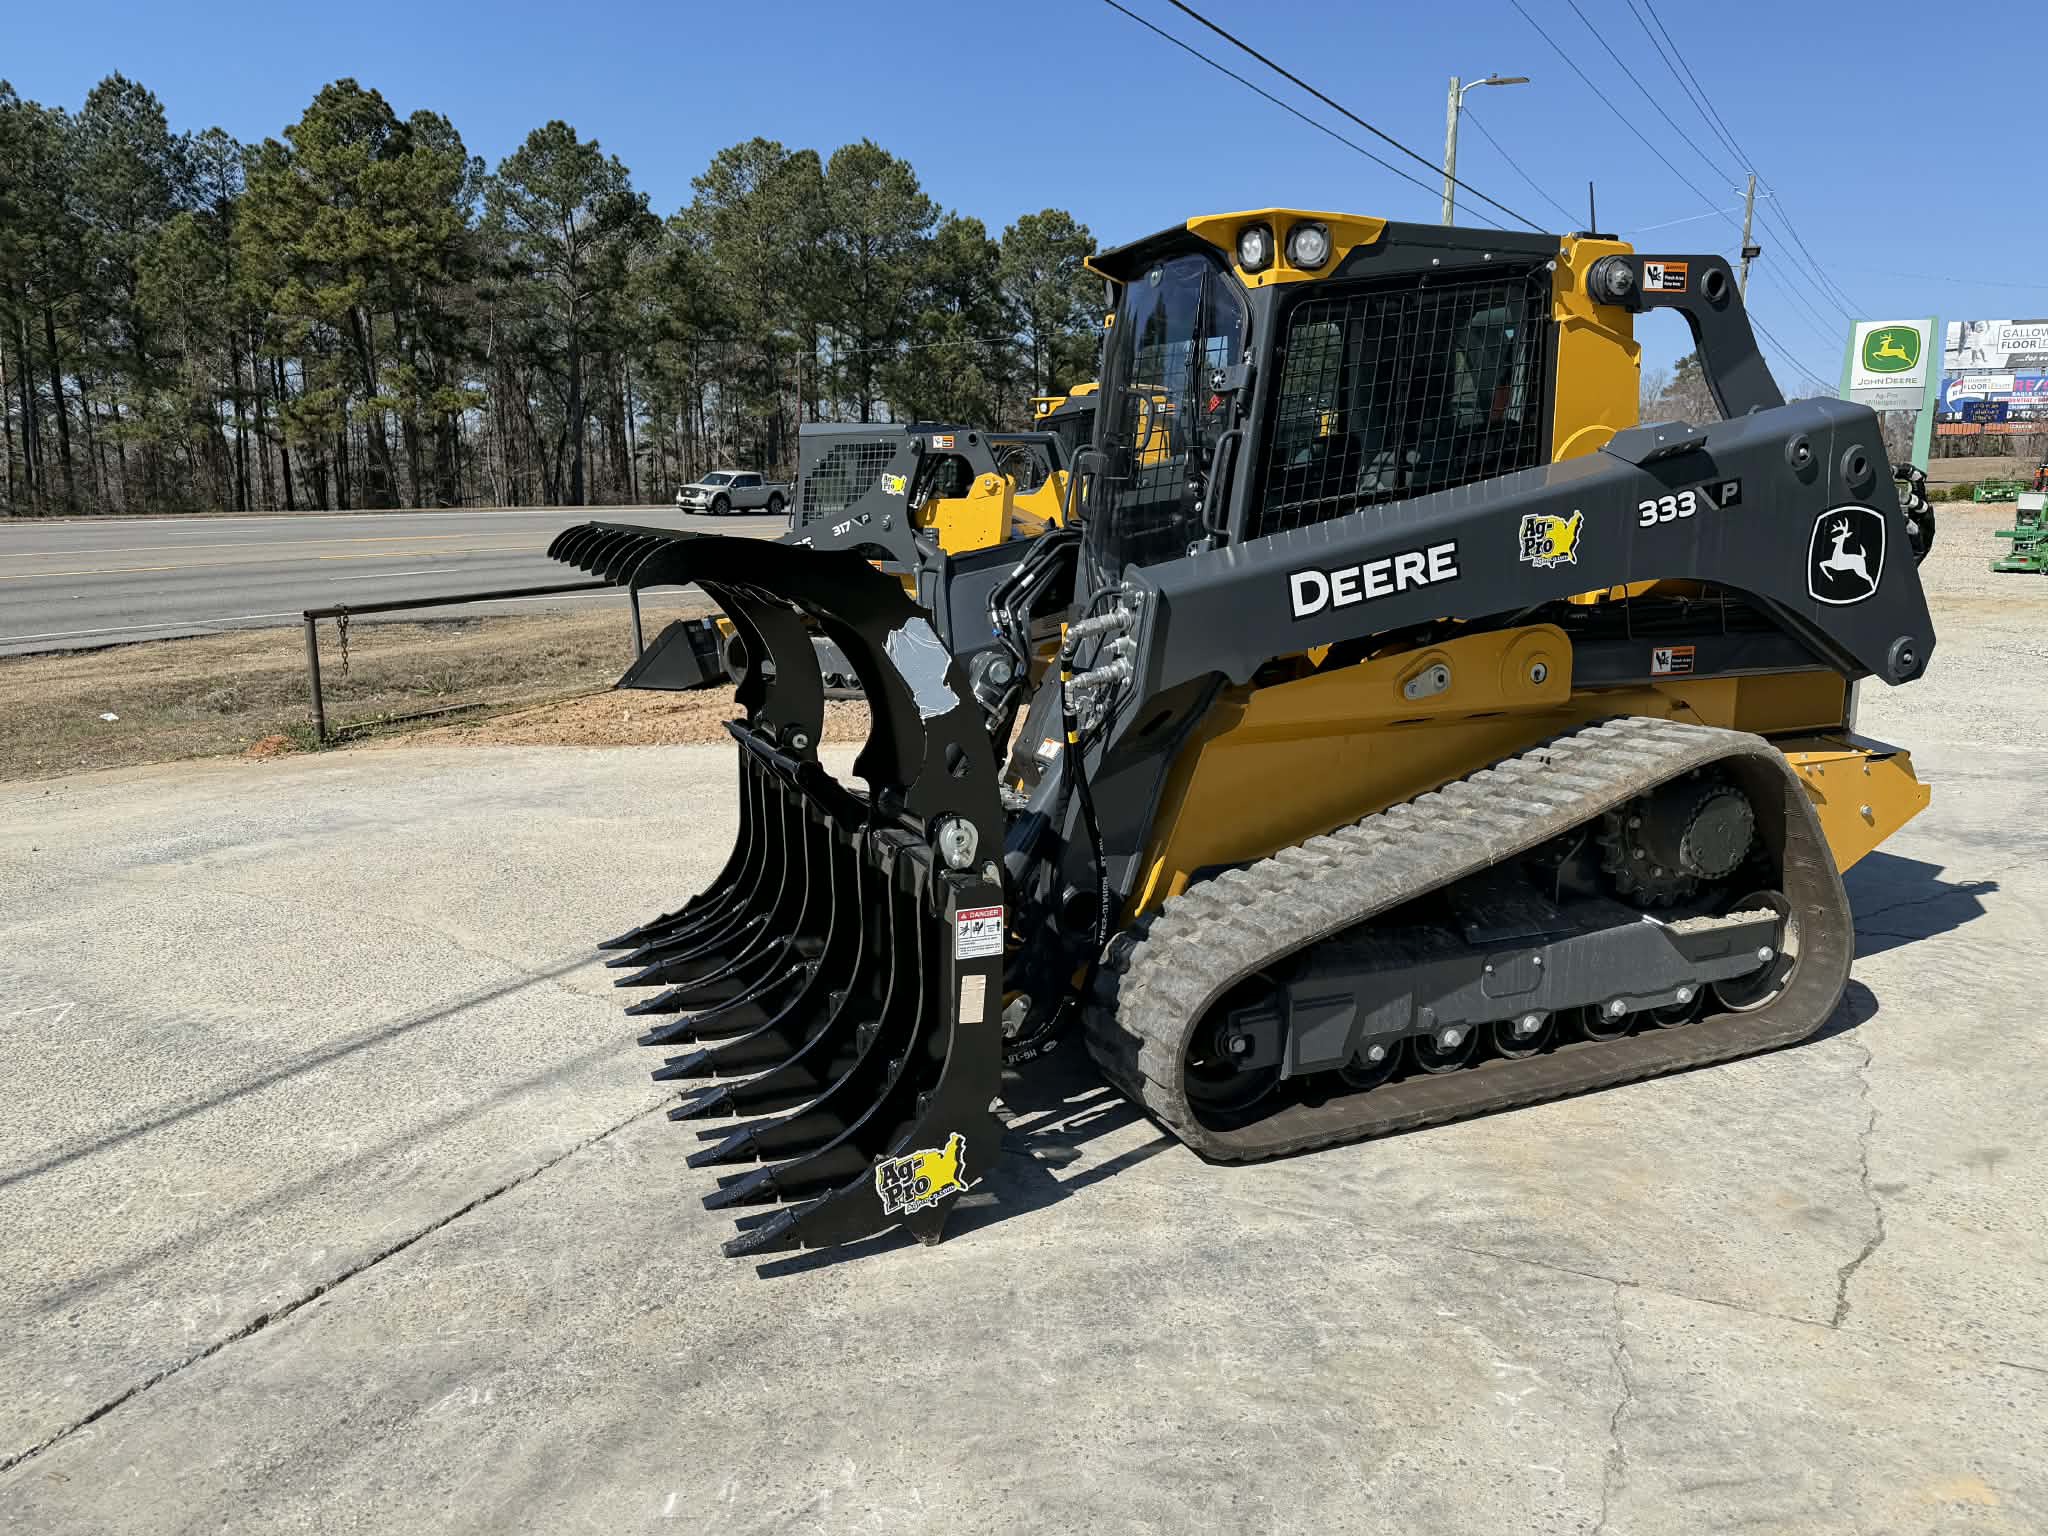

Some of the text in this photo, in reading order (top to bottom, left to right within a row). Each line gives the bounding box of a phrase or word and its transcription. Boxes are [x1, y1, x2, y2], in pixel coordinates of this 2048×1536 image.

[2001, 340, 2037, 349] FLOOR
[1857, 377, 1918, 386] JOHN DEERE
[1638, 490, 1697, 528] 333
[831, 520, 851, 537] 317
[1522, 518, 1553, 540] Ag-
[1523, 537, 1553, 557] Pro
[1289, 542, 1458, 618] DEERE
[969, 909, 999, 919] DANGER
[881, 1158, 924, 1190] Ag-
[885, 1176, 931, 1211] Pro
